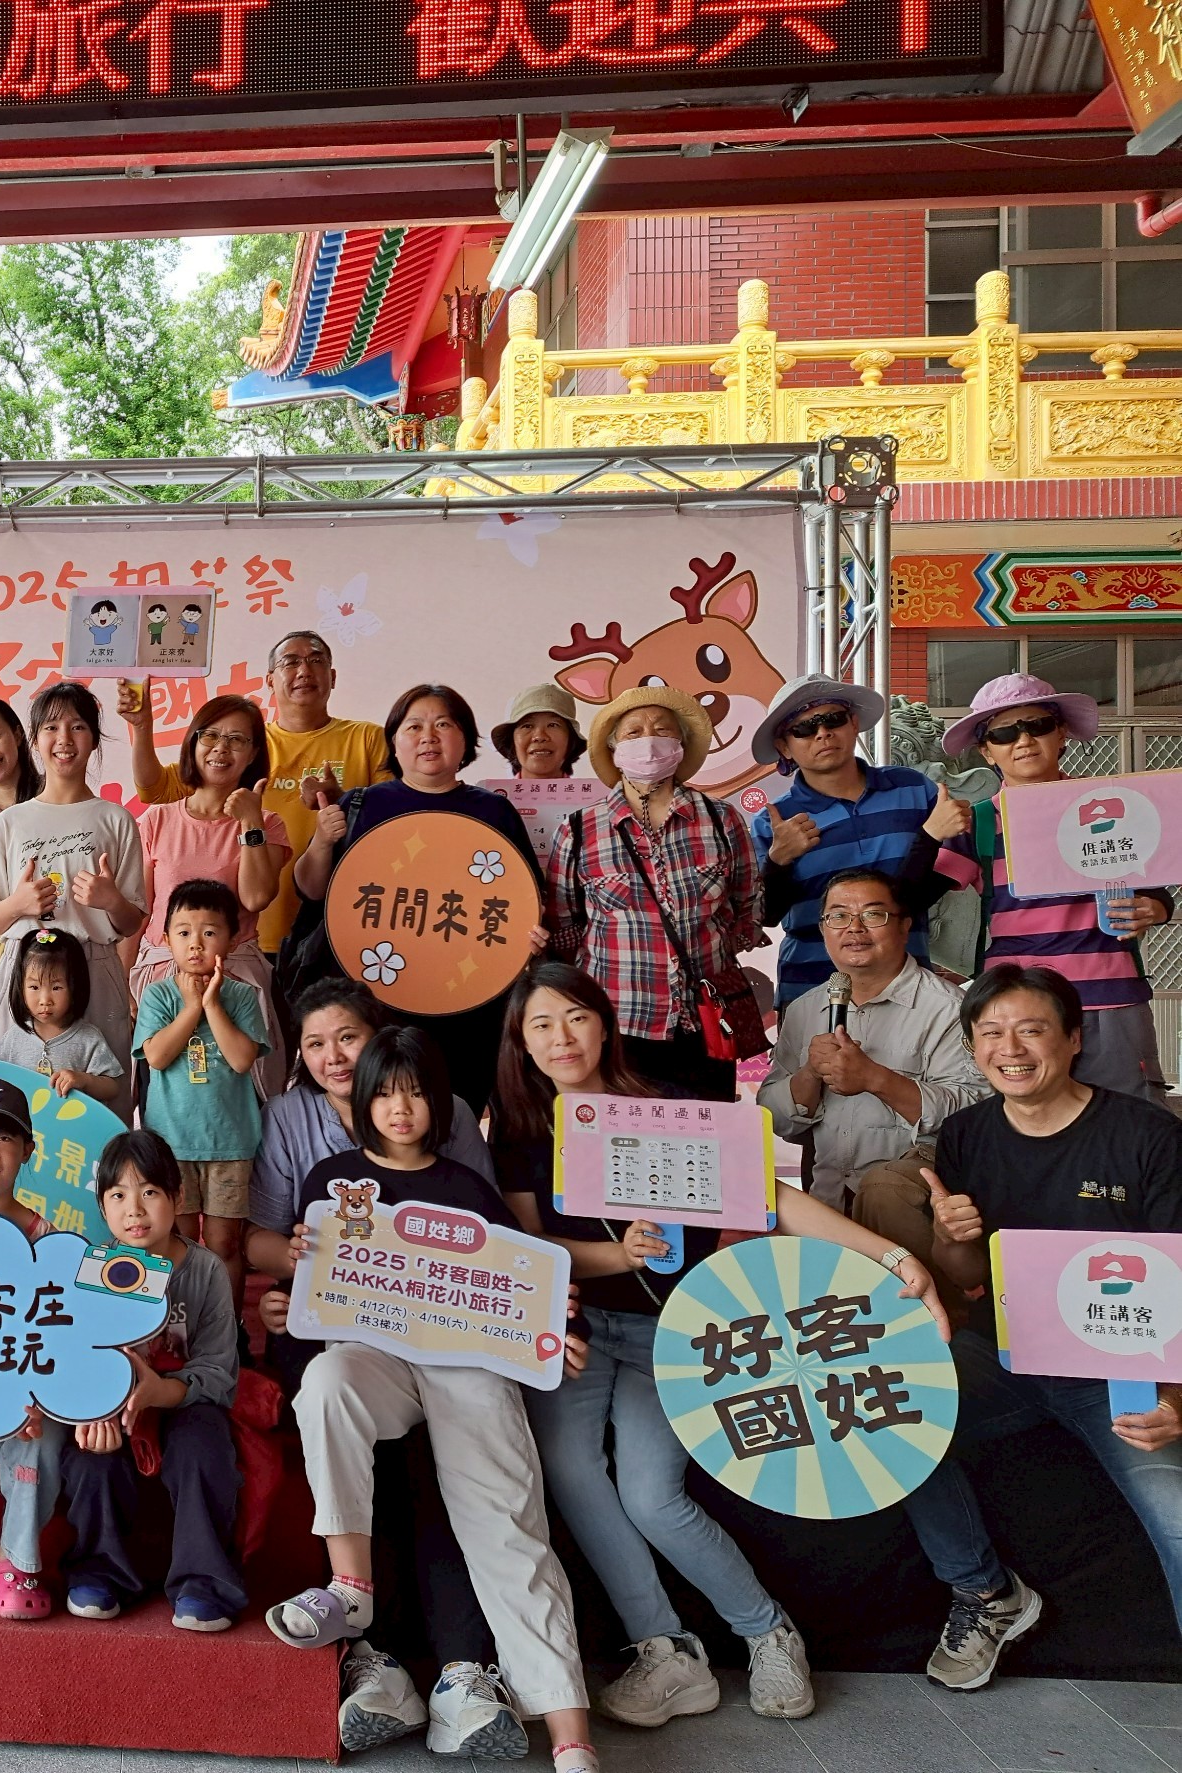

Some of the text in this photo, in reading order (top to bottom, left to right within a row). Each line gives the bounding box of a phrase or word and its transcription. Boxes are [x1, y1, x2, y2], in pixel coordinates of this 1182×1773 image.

[89, 648, 115, 657] 大家好
[273, 777, 296, 790] NO
[21, 831, 94, 853] Today is going
[47, 843, 80, 864] good
[78, 842, 97, 856] day
[1080, 852, 1139, 868] 客語友善環境
[606, 1102, 712, 1124] 客語闖過關
[404, 1215, 476, 1246] 國姓鄉
[355, 1313, 409, 1335] (共3梯次)
[1082, 1323, 1158, 1339] 客語友善環境
[690, 1294, 886, 1386] 好客
[712, 1365, 923, 1461] 國姓
